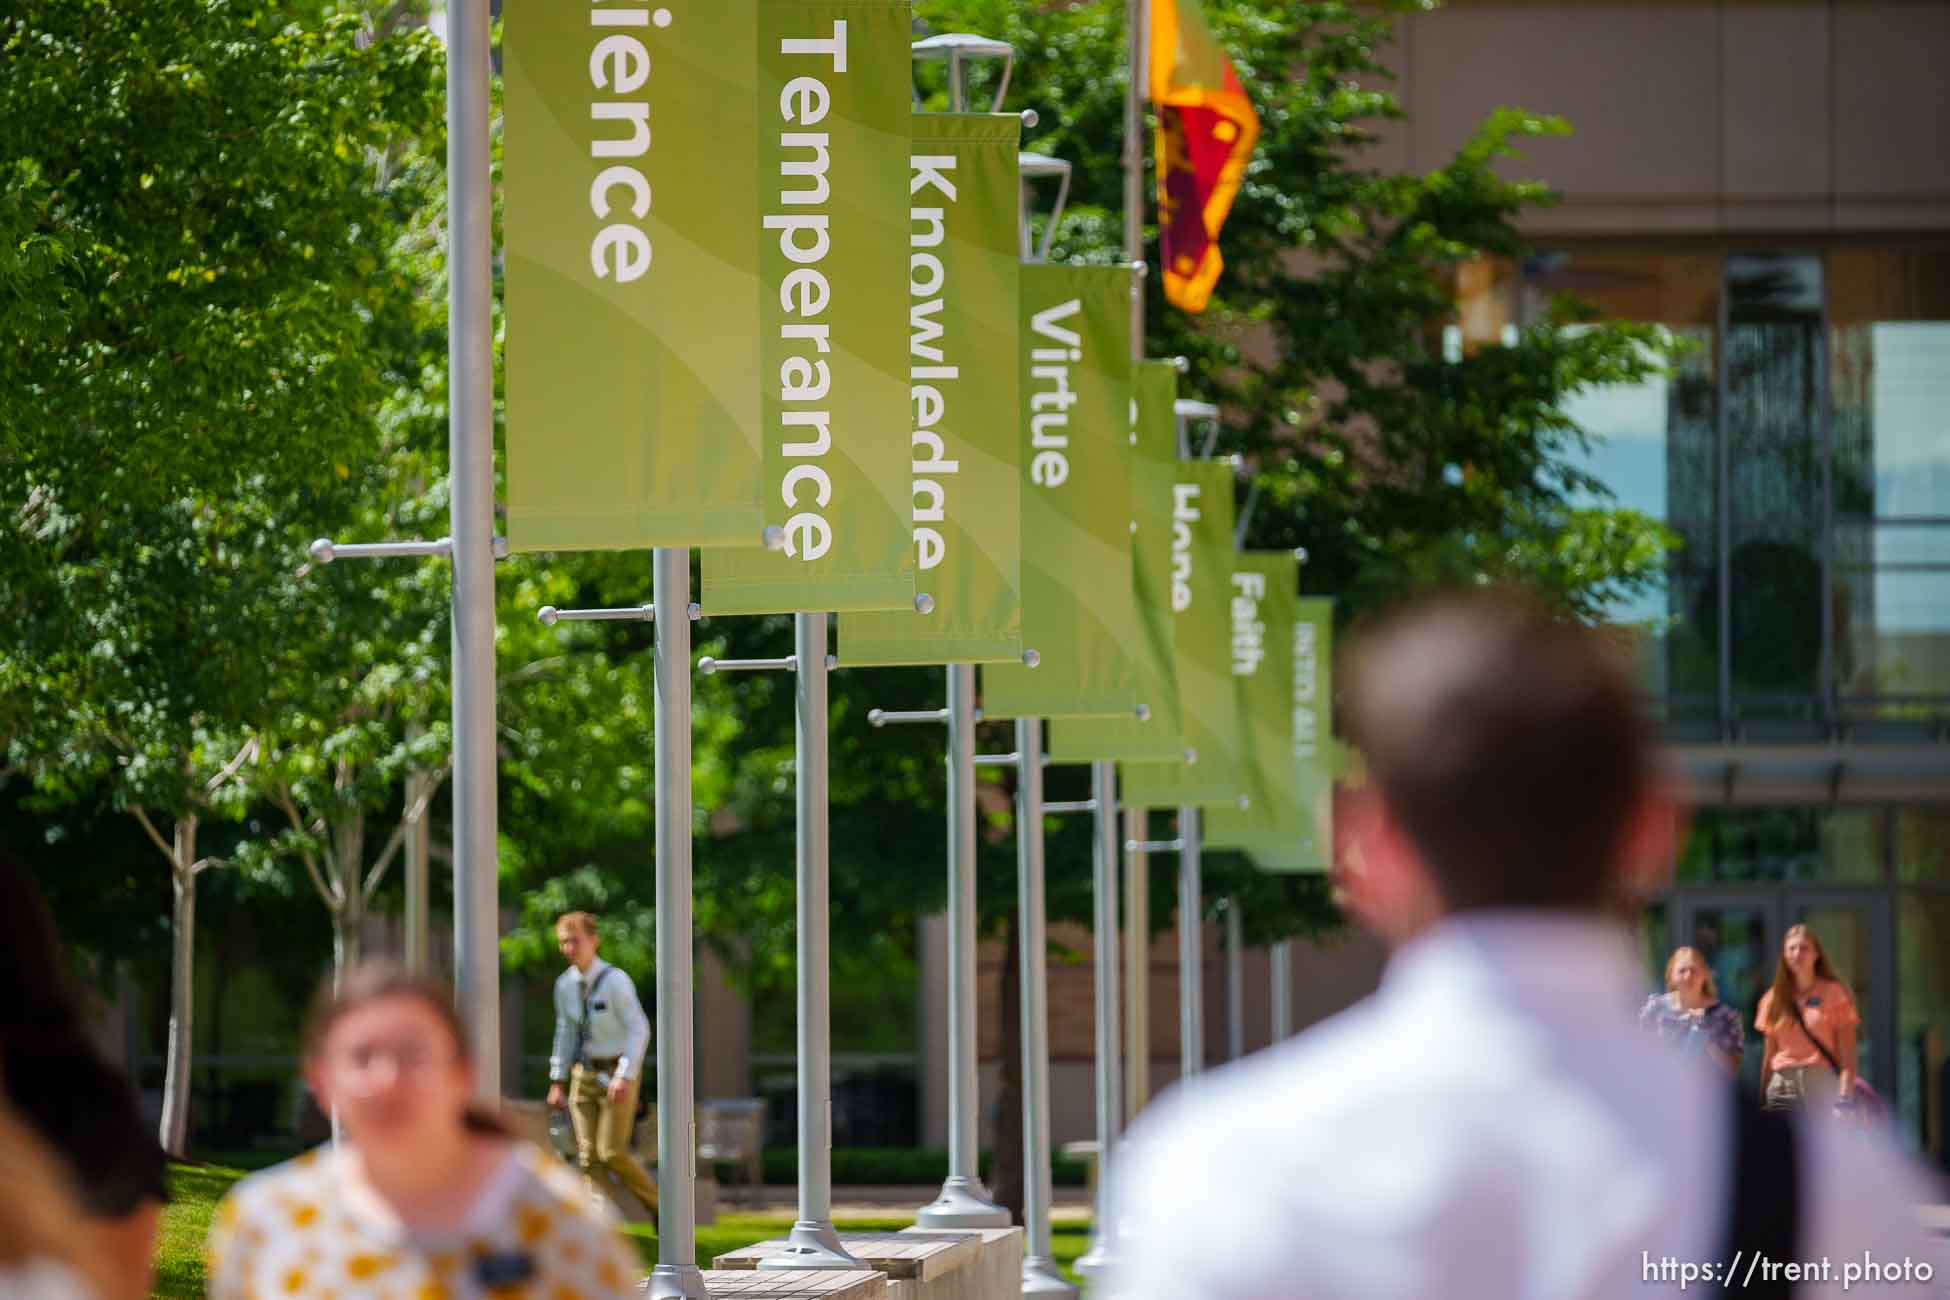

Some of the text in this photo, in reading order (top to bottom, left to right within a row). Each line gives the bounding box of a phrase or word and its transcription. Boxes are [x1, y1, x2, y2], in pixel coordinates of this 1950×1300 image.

[589, 0, 672, 283] ience
[763, 20, 847, 561] Temperance
[1030, 299, 1082, 488] Virtue
[1231, 572, 1265, 676] Faith
